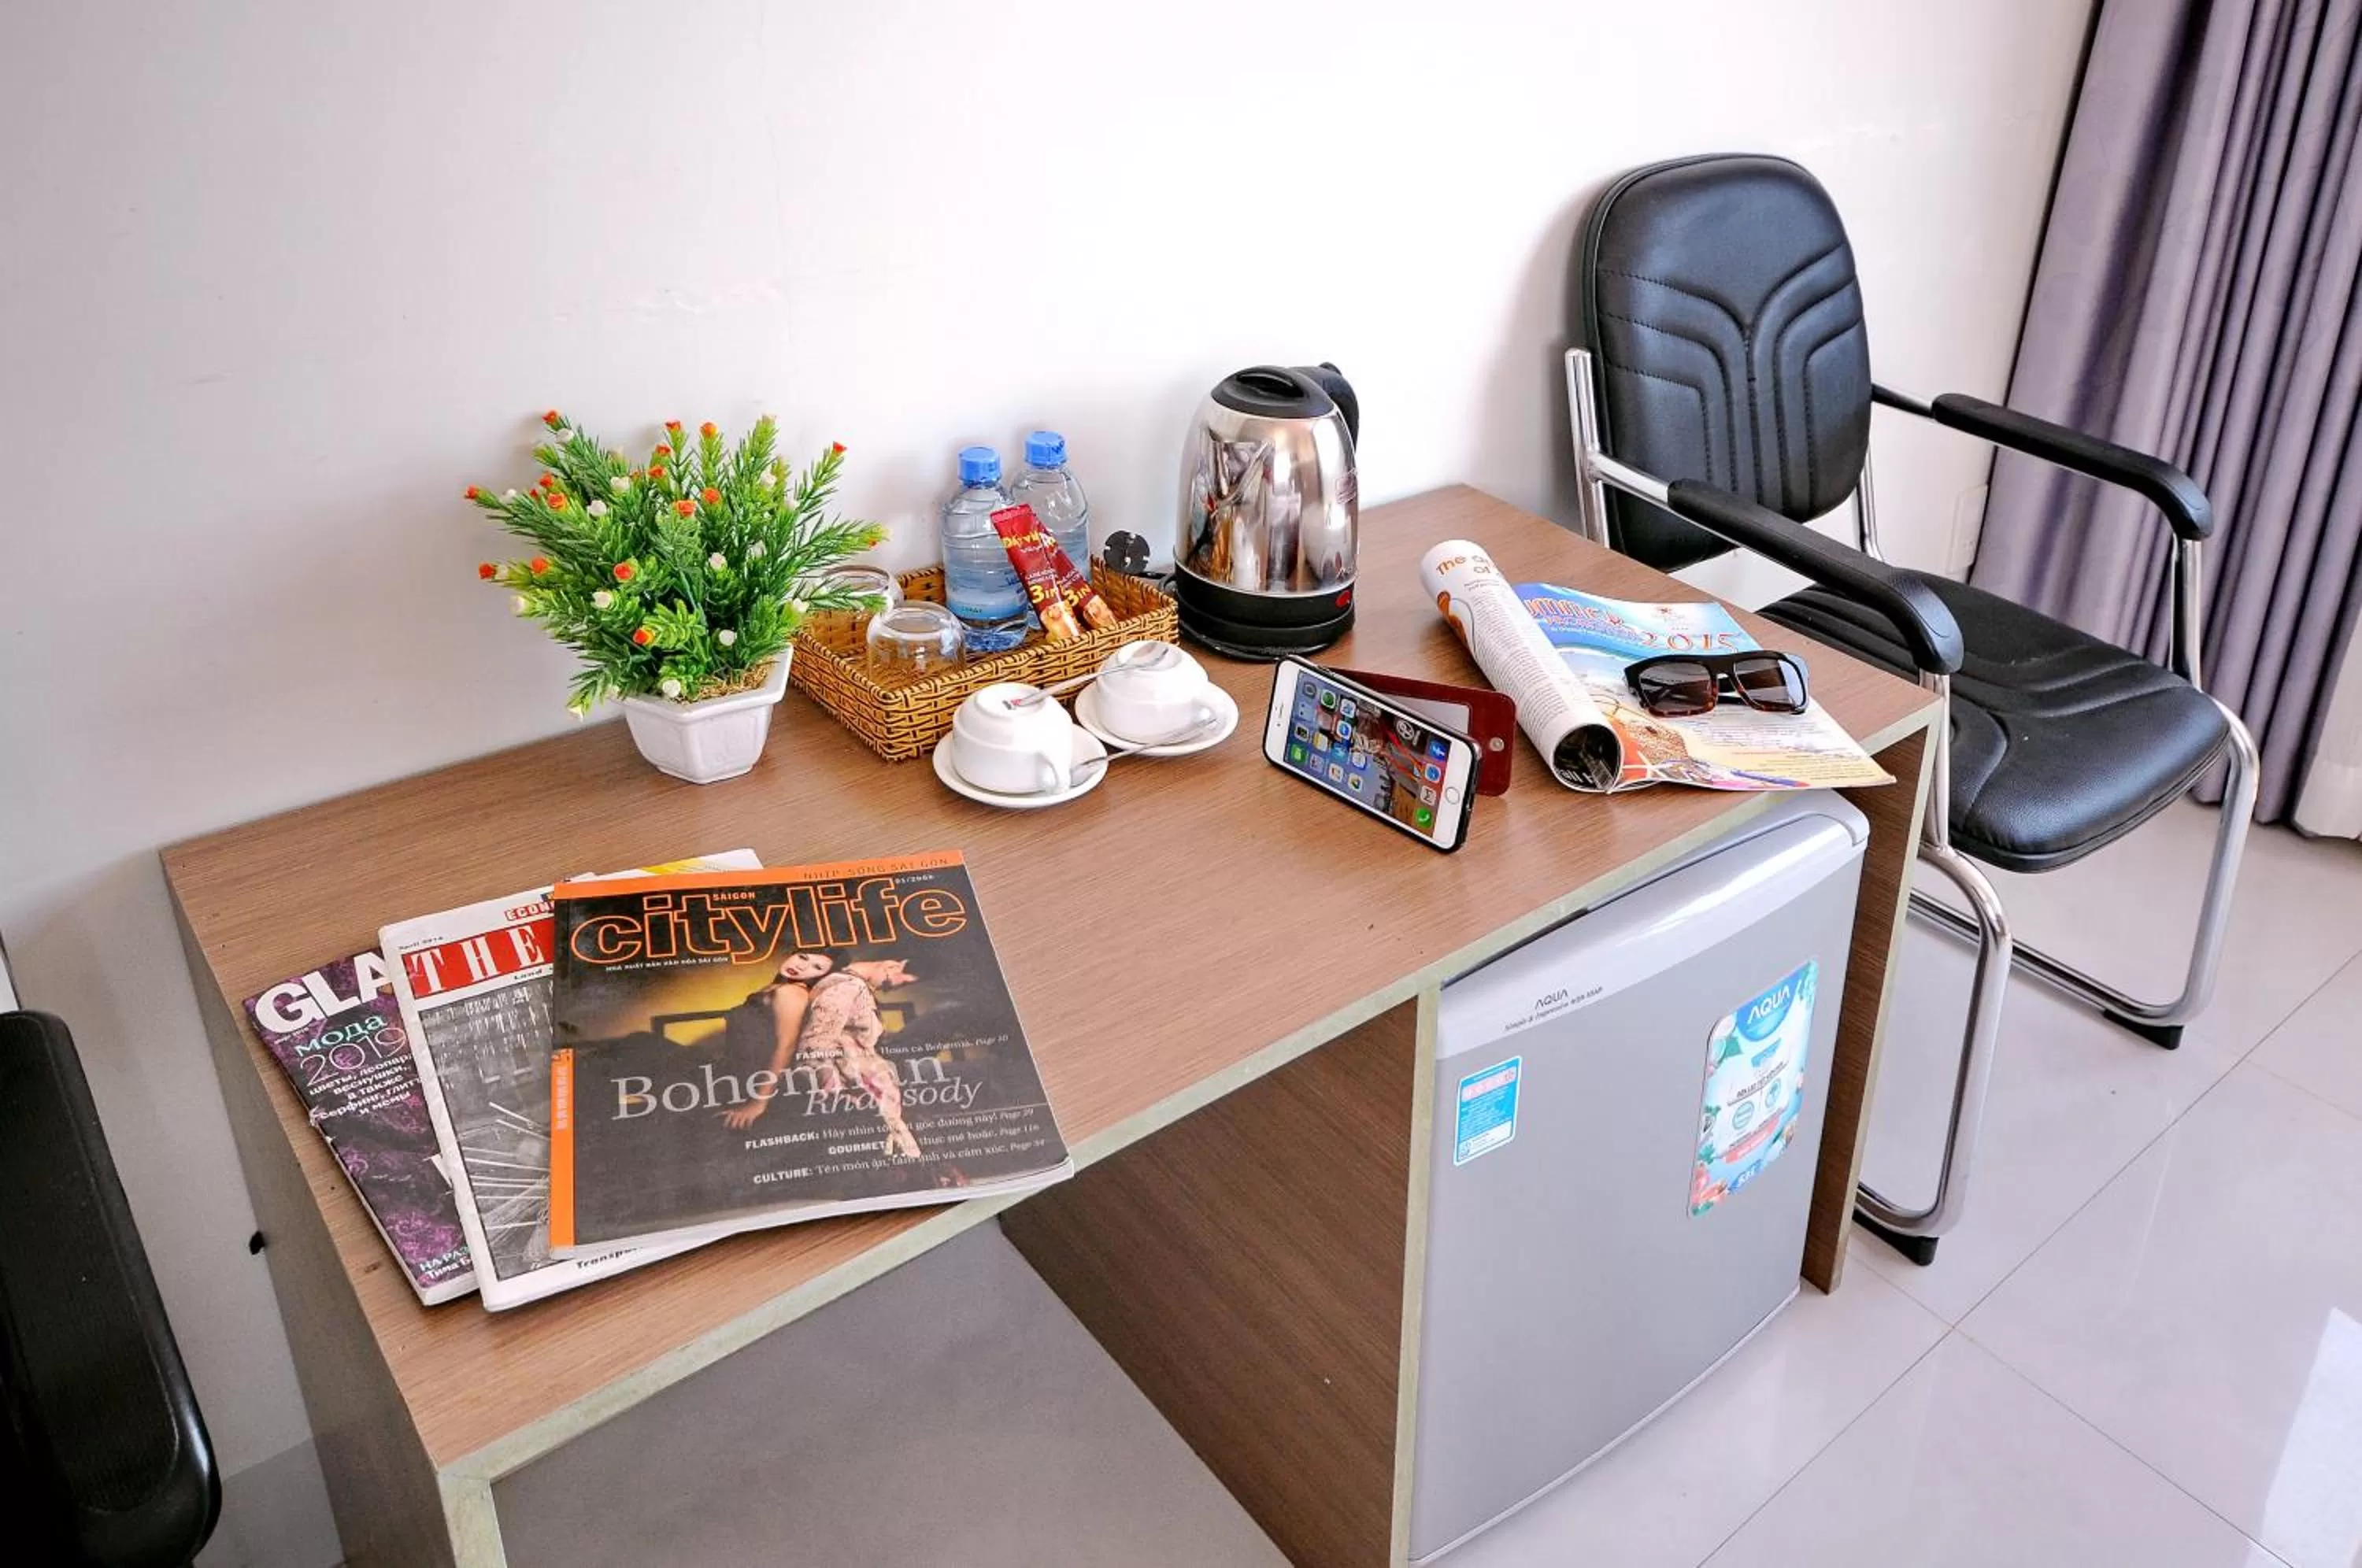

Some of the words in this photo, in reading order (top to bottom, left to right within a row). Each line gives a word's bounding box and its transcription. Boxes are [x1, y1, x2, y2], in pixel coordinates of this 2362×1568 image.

[1641, 631, 1742, 653] 2015
[713, 890, 755, 901] SAIGON
[504, 902, 554, 921] ECON
[571, 875, 967, 964] citylife
[411, 924, 546, 994] THE
[1535, 989, 1568, 1009] AQUA
[1747, 985, 1790, 1024] AQUA
[746, 1130, 819, 1150] FLASHBACK:
[753, 1167, 814, 1184] CULTURE:
